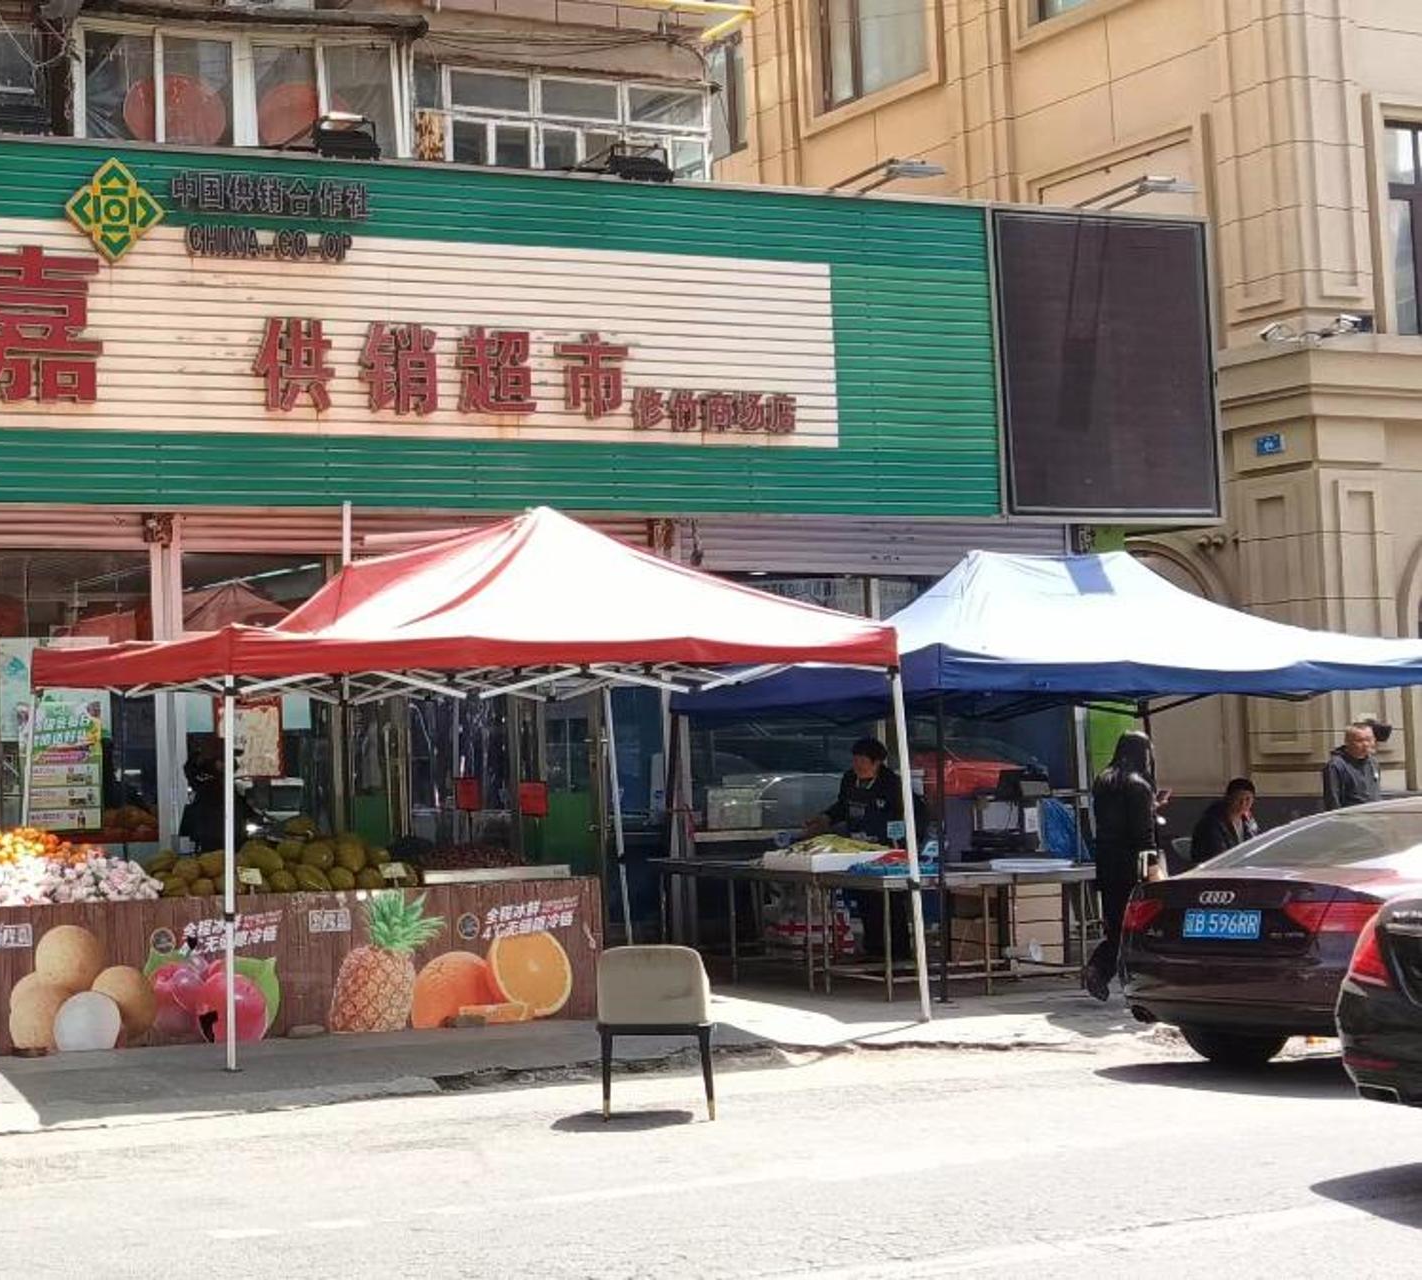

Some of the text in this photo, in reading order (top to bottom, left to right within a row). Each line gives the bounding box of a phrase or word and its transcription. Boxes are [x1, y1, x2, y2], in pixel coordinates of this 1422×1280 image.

[170, 169, 374, 221] 中国供销合作社
[252, 316, 630, 421] 供销超市
[631, 386, 797, 436] 修竹商场店
